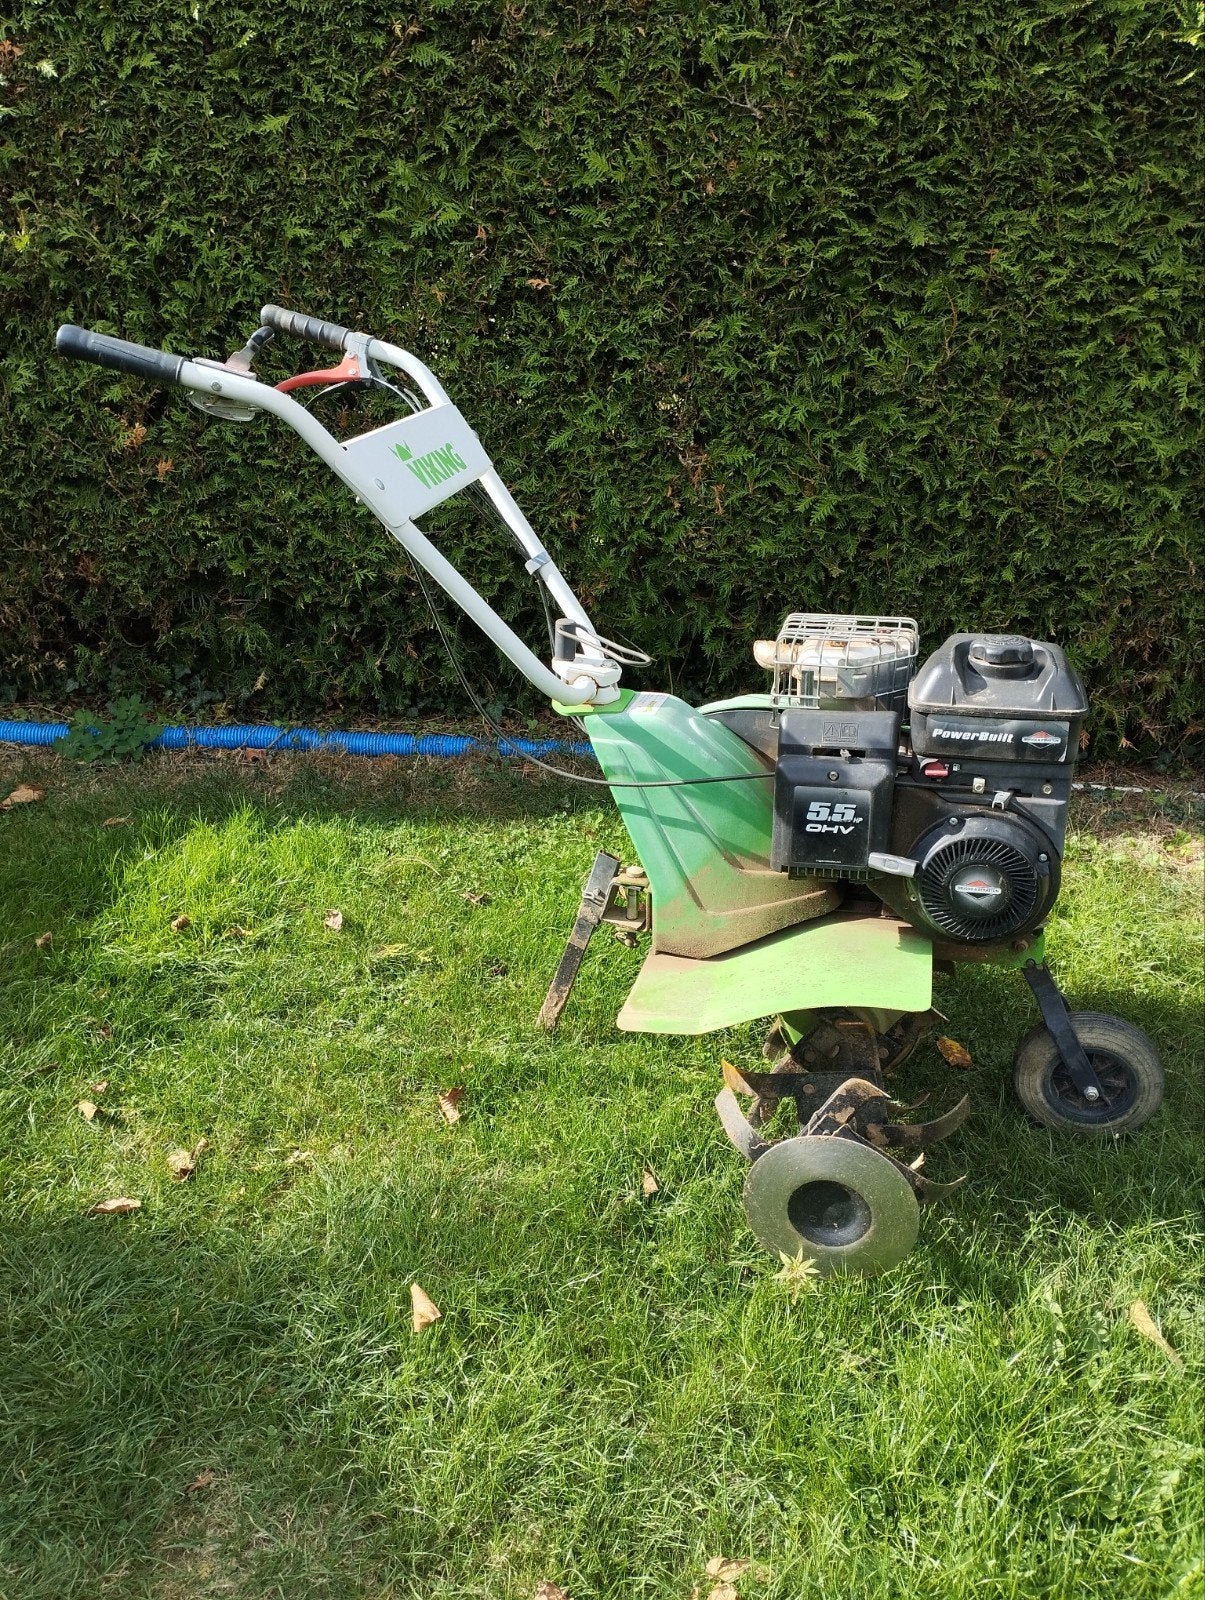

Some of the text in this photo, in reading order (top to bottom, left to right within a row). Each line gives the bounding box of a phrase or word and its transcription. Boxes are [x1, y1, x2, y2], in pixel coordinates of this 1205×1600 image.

[406, 442, 467, 489] VIKING
[932, 728, 1014, 743] PowerBuilt
[806, 801, 857, 822] 5.5
[805, 823, 855, 834] OHV
